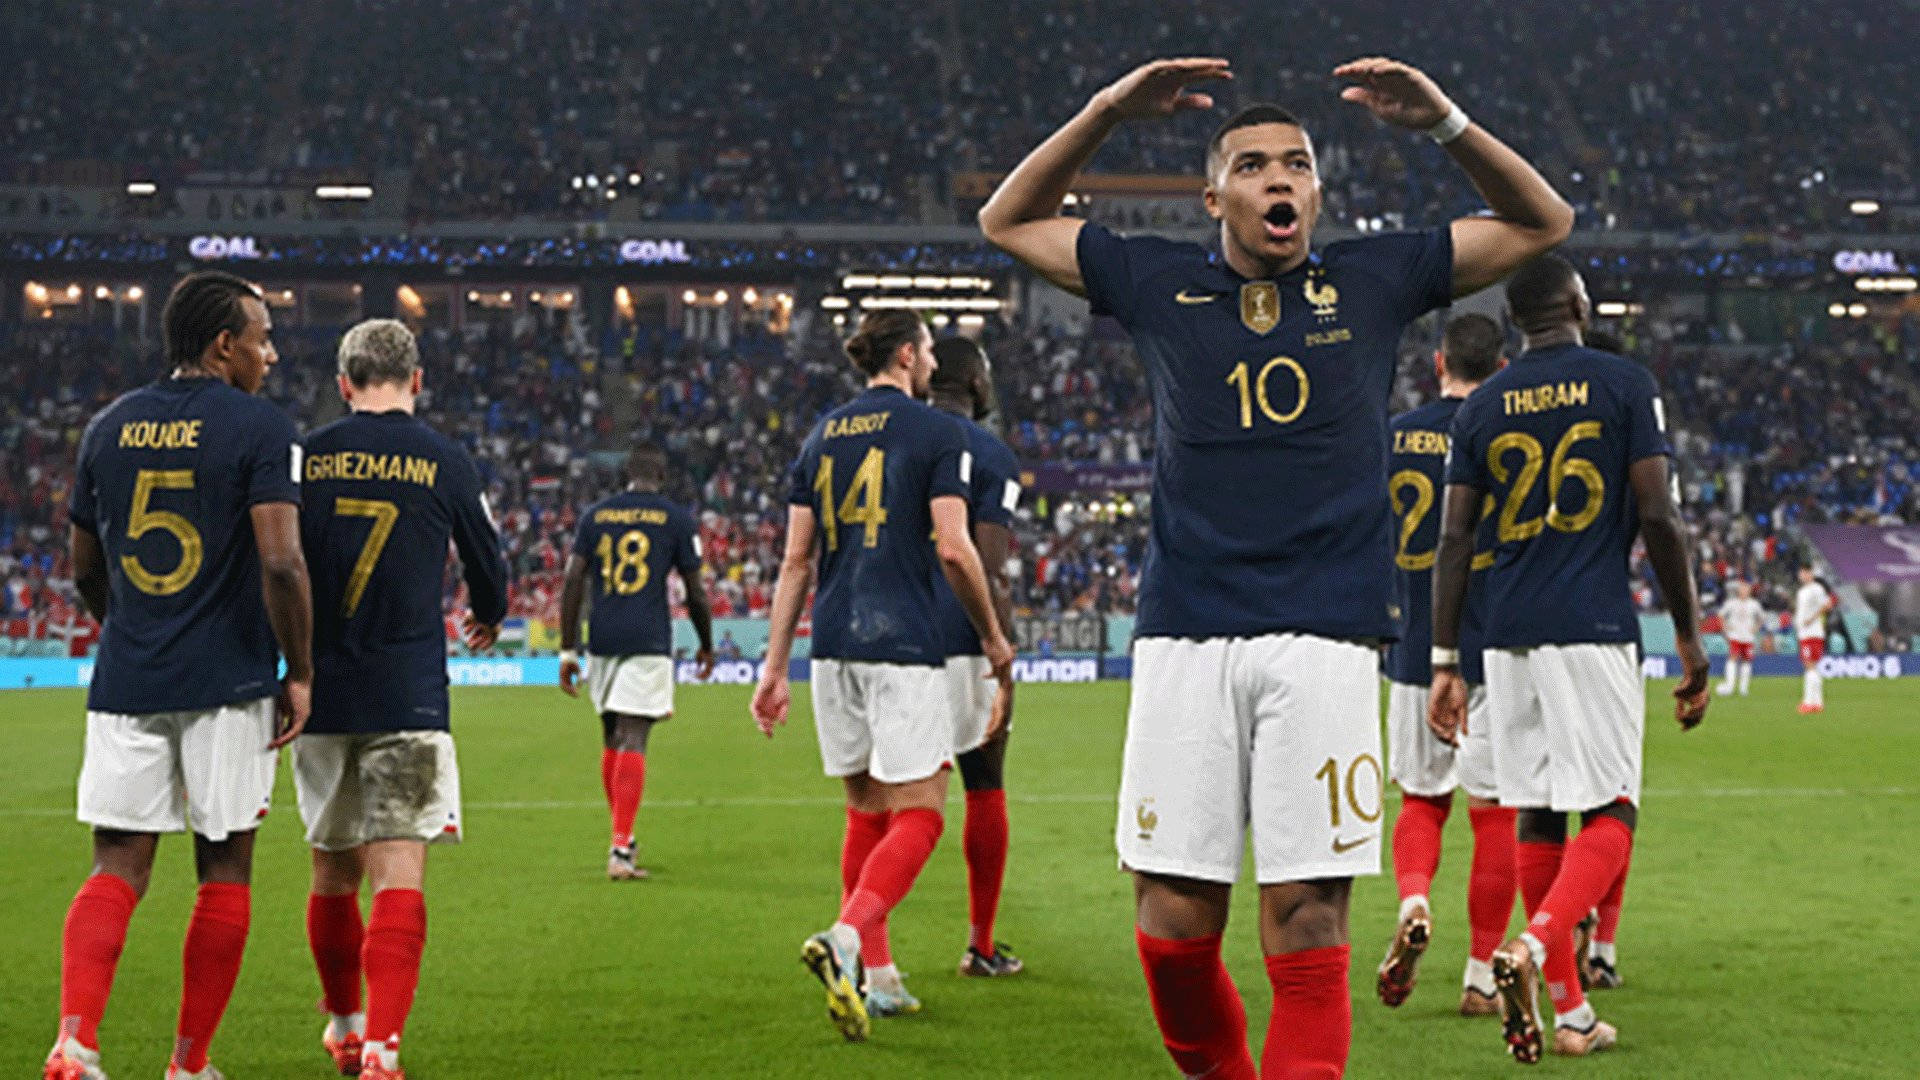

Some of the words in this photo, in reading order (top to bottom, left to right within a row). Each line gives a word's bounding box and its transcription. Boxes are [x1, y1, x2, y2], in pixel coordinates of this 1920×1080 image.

[190, 236, 261, 259] GOAL
[622, 240, 690, 262] GOAL
[1834, 251, 1899, 272] GOAL
[1226, 357, 1309, 428] 10
[1503, 380, 1588, 415] THURAM
[823, 411, 890, 439] RABIOT
[305, 450, 438, 487] GRIEZMANN
[1487, 420, 1604, 543] 26
[813, 446, 888, 552] 14
[121, 469, 204, 594] 5
[335, 497, 399, 618] 7
[596, 530, 650, 597] 18
[1817, 656, 1880, 678] ONIQ
[1315, 753, 1383, 828] 10
